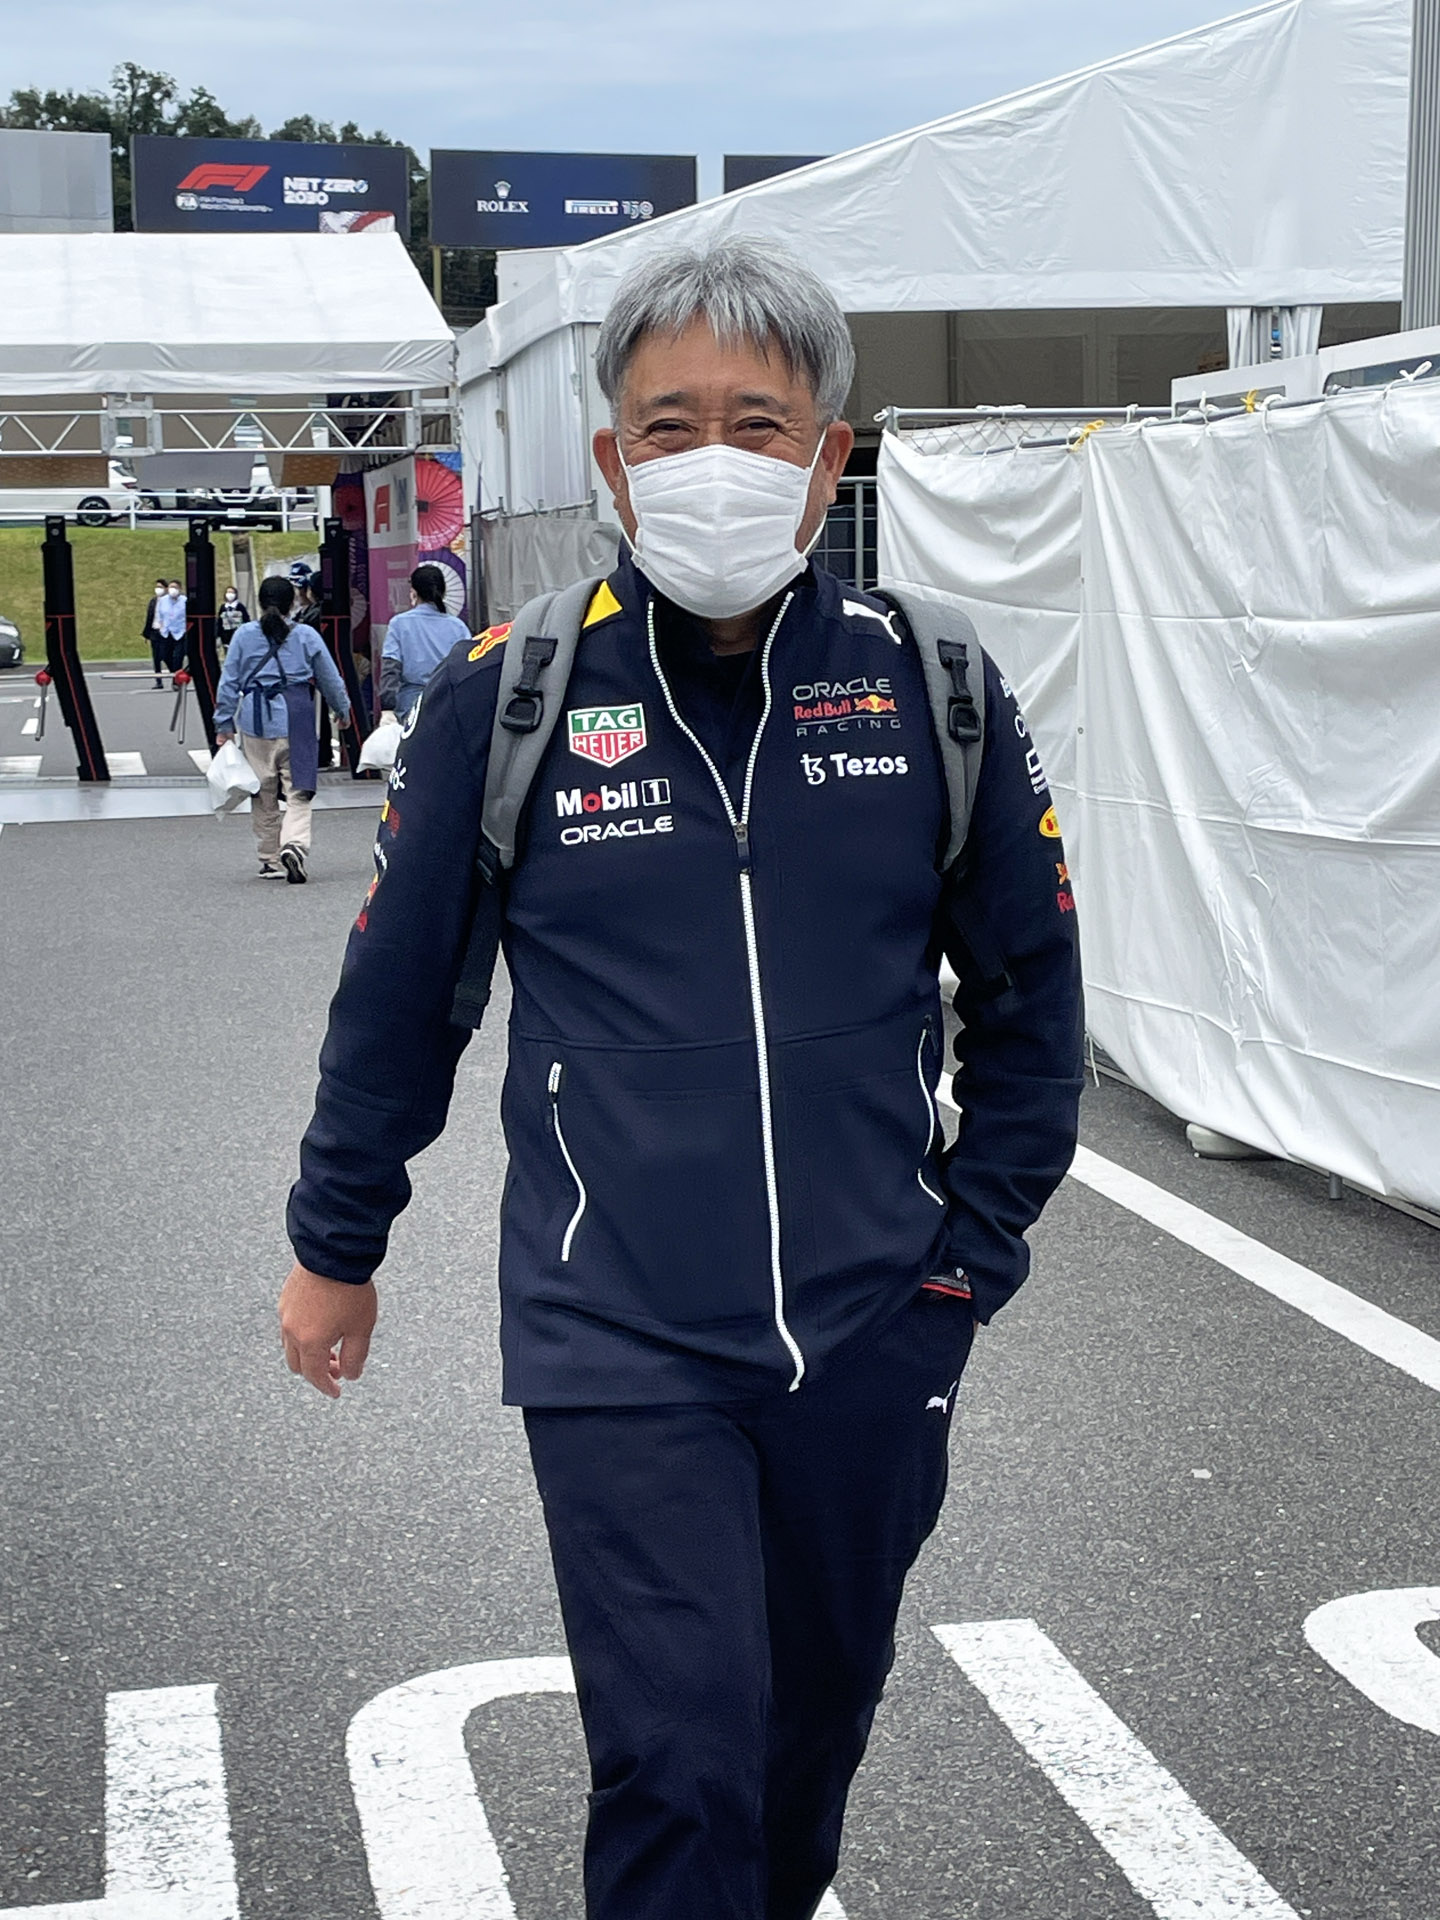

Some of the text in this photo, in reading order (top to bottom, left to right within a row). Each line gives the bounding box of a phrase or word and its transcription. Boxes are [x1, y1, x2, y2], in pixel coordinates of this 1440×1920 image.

[283, 176, 369, 193] NET ZERO
[283, 190, 329, 205] 2030
[477, 200, 530, 213] ROLEX
[564, 200, 619, 215] PIRELLI
[792, 677, 893, 701] ORACLE
[574, 709, 639, 732] TAG
[796, 718, 902, 737] RACING
[574, 732, 642, 762] HEUER
[829, 752, 909, 777] Tezos
[555, 781, 638, 817] Mobil
[560, 815, 674, 845] ORACLE
